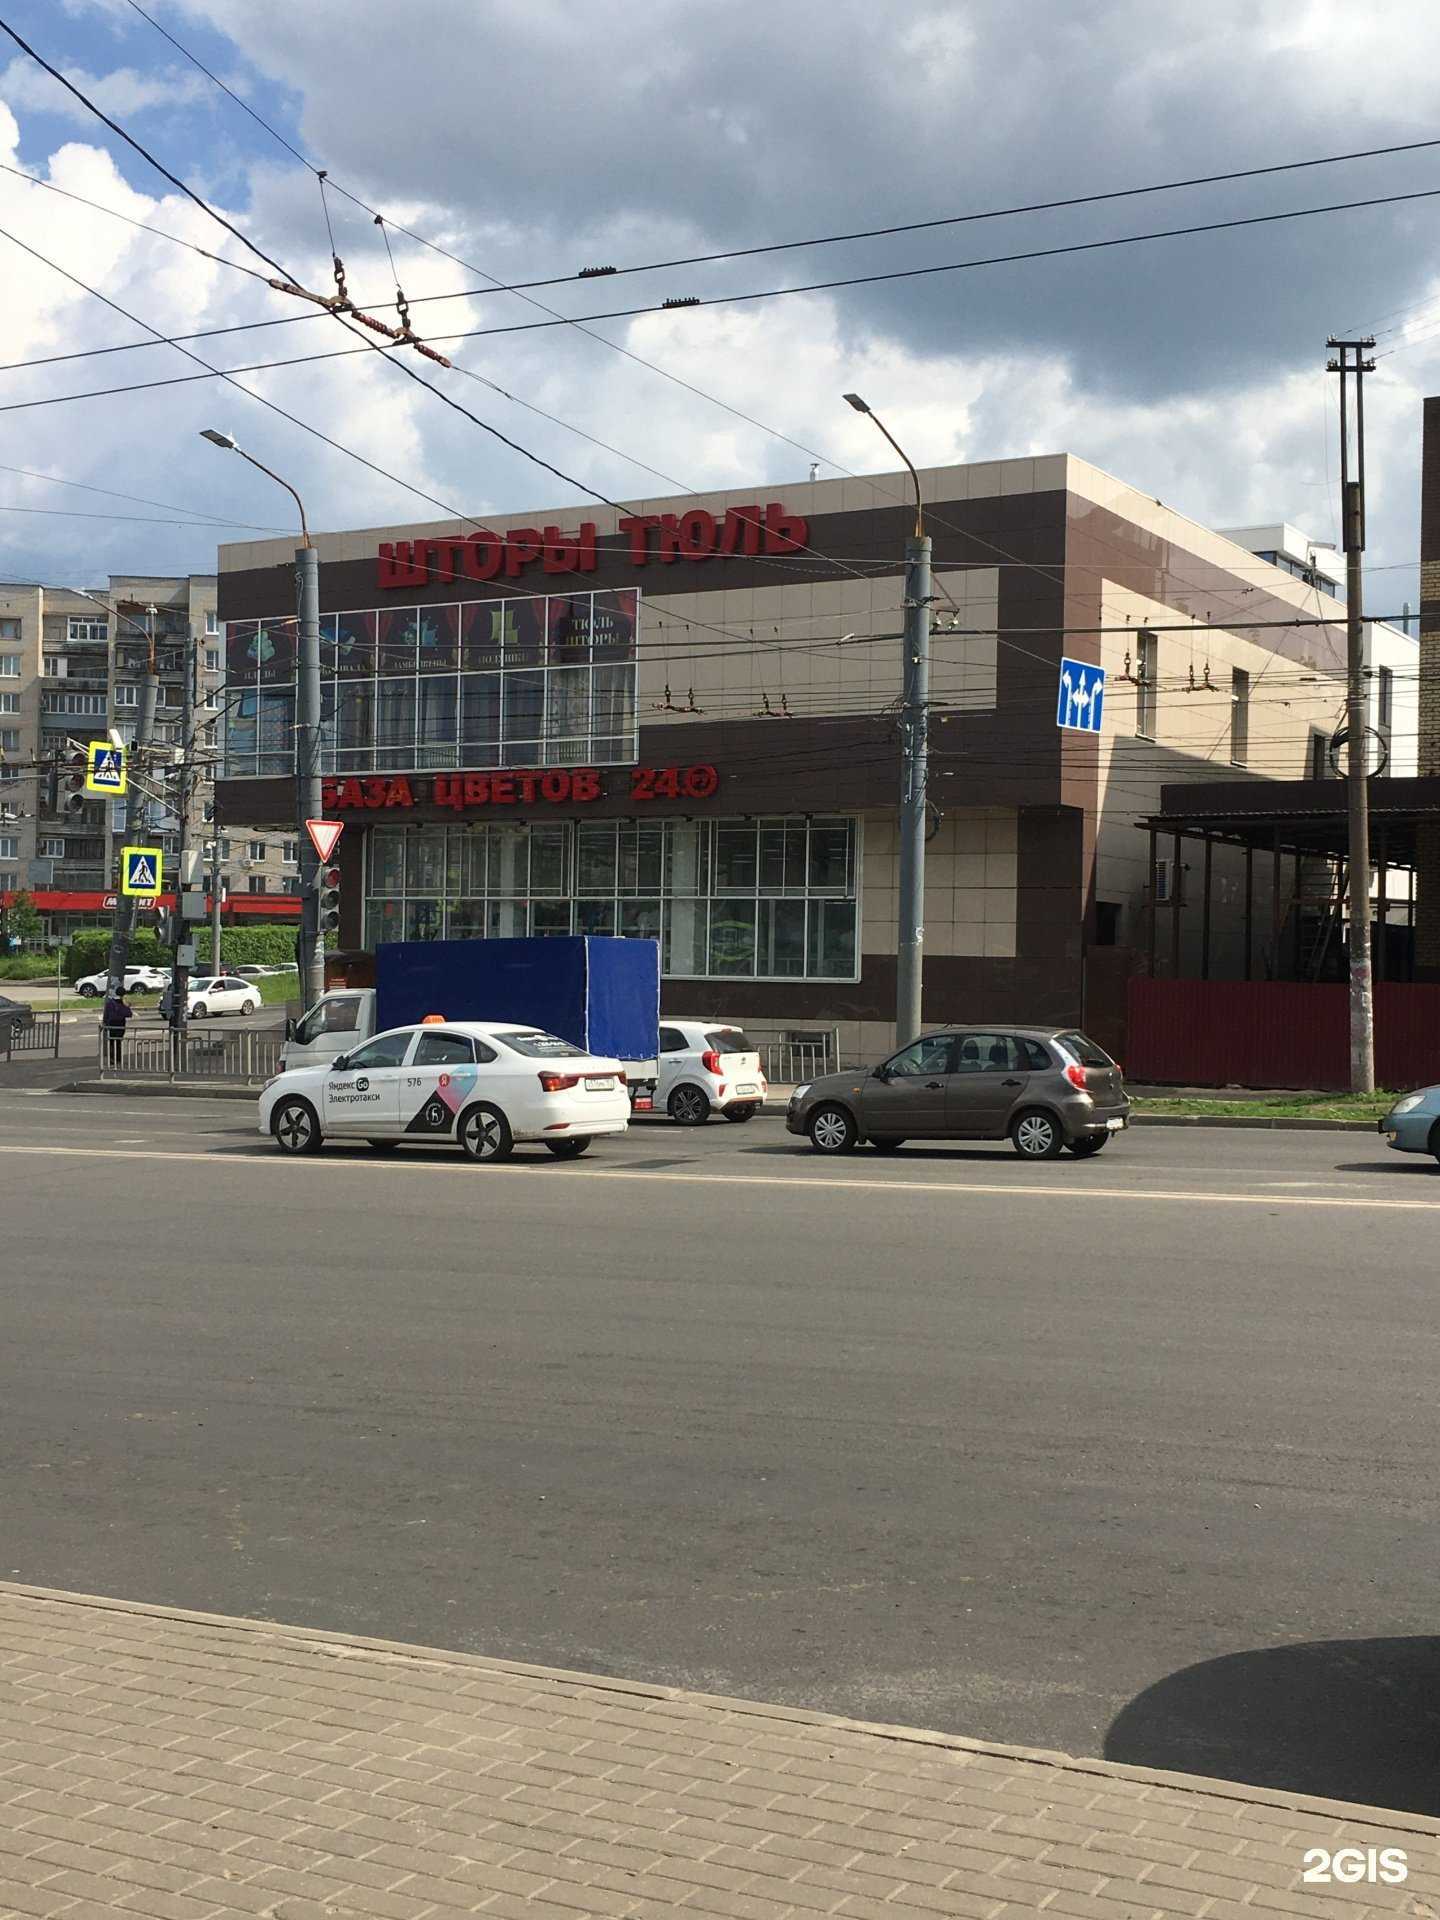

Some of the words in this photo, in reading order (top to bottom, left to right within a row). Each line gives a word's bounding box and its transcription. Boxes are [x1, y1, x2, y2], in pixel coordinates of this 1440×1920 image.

[377, 522, 597, 589] ШТОРЫ
[619, 502, 809, 567] ТЮЛЬ
[433, 766, 601, 812] ЦВЕТОВ
[328, 1081, 356, 1091] Яндекс
[358, 1079, 369, 1088] Go
[407, 1077, 422, 1088] 576
[328, 1093, 381, 1104] Электротакси
